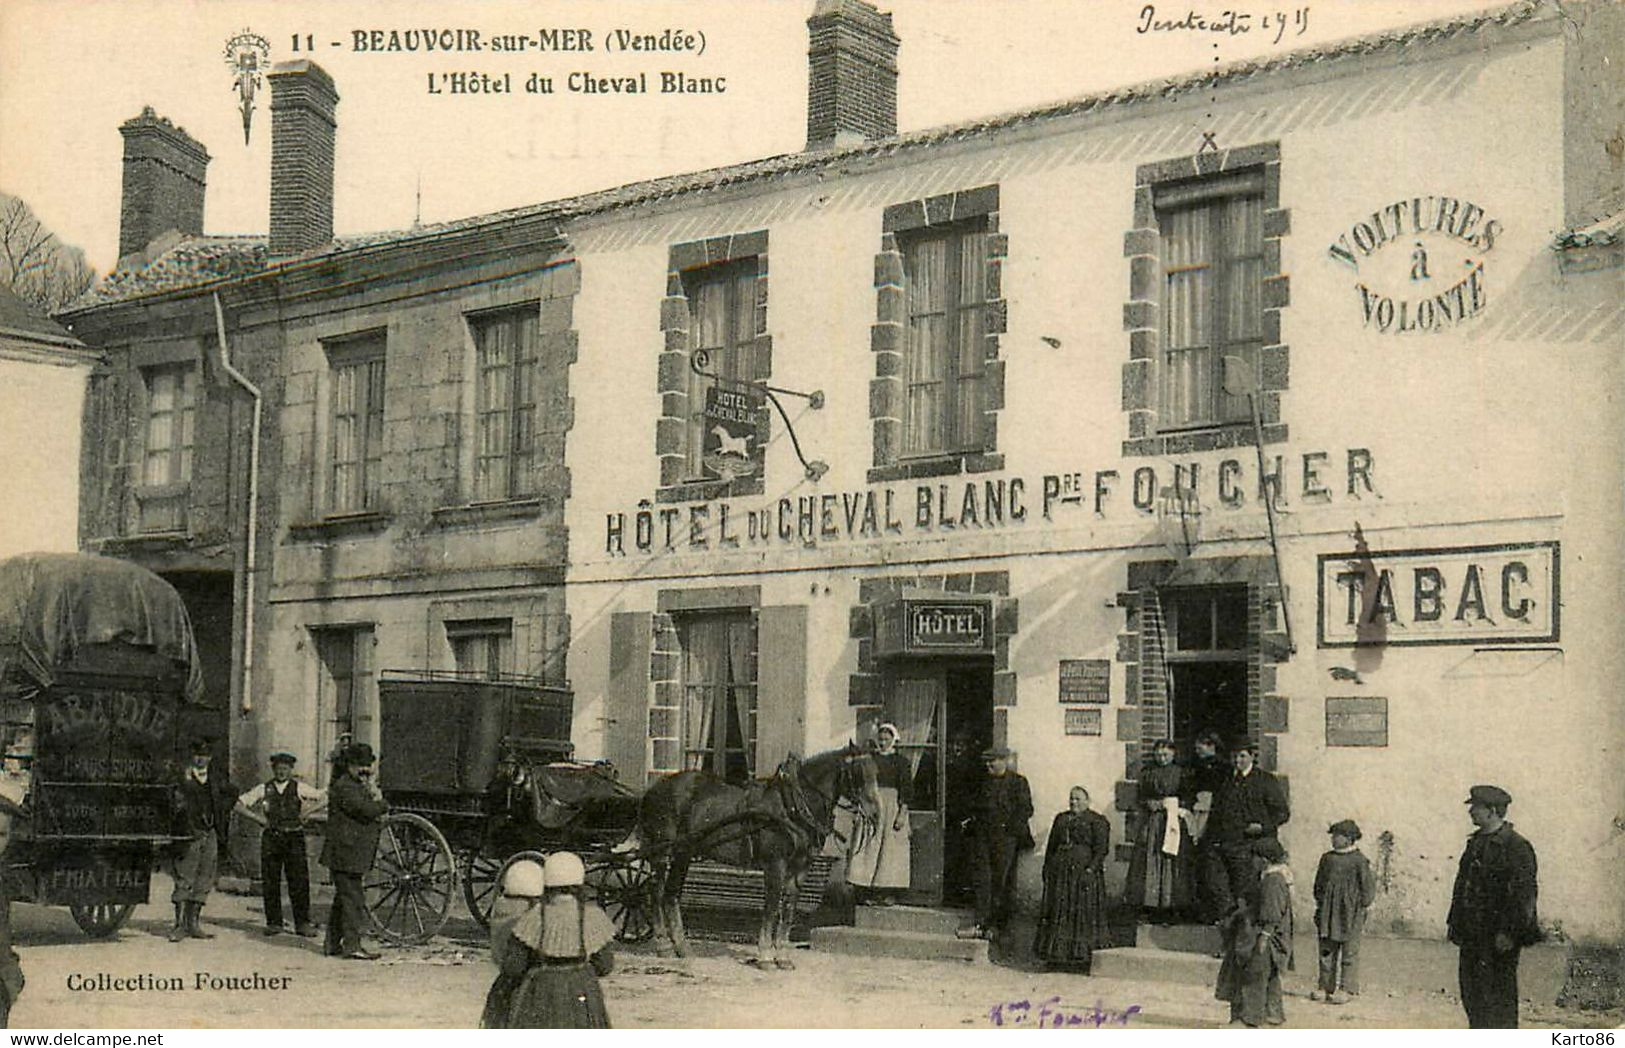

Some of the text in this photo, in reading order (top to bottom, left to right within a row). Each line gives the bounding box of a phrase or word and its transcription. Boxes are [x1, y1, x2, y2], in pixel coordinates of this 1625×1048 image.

[1329, 196, 1503, 269] VOITURES
[1412, 243, 1430, 280] à
[606, 499, 739, 556] HÔTEL
[748, 509, 771, 542] DU
[777, 492, 900, 548] CHEVAL
[916, 478, 1024, 530] BLANC
[1094, 448, 1375, 520] FOUCHER
[918, 609, 979, 635] HÔTEL
[1337, 561, 1530, 624] TABAC
